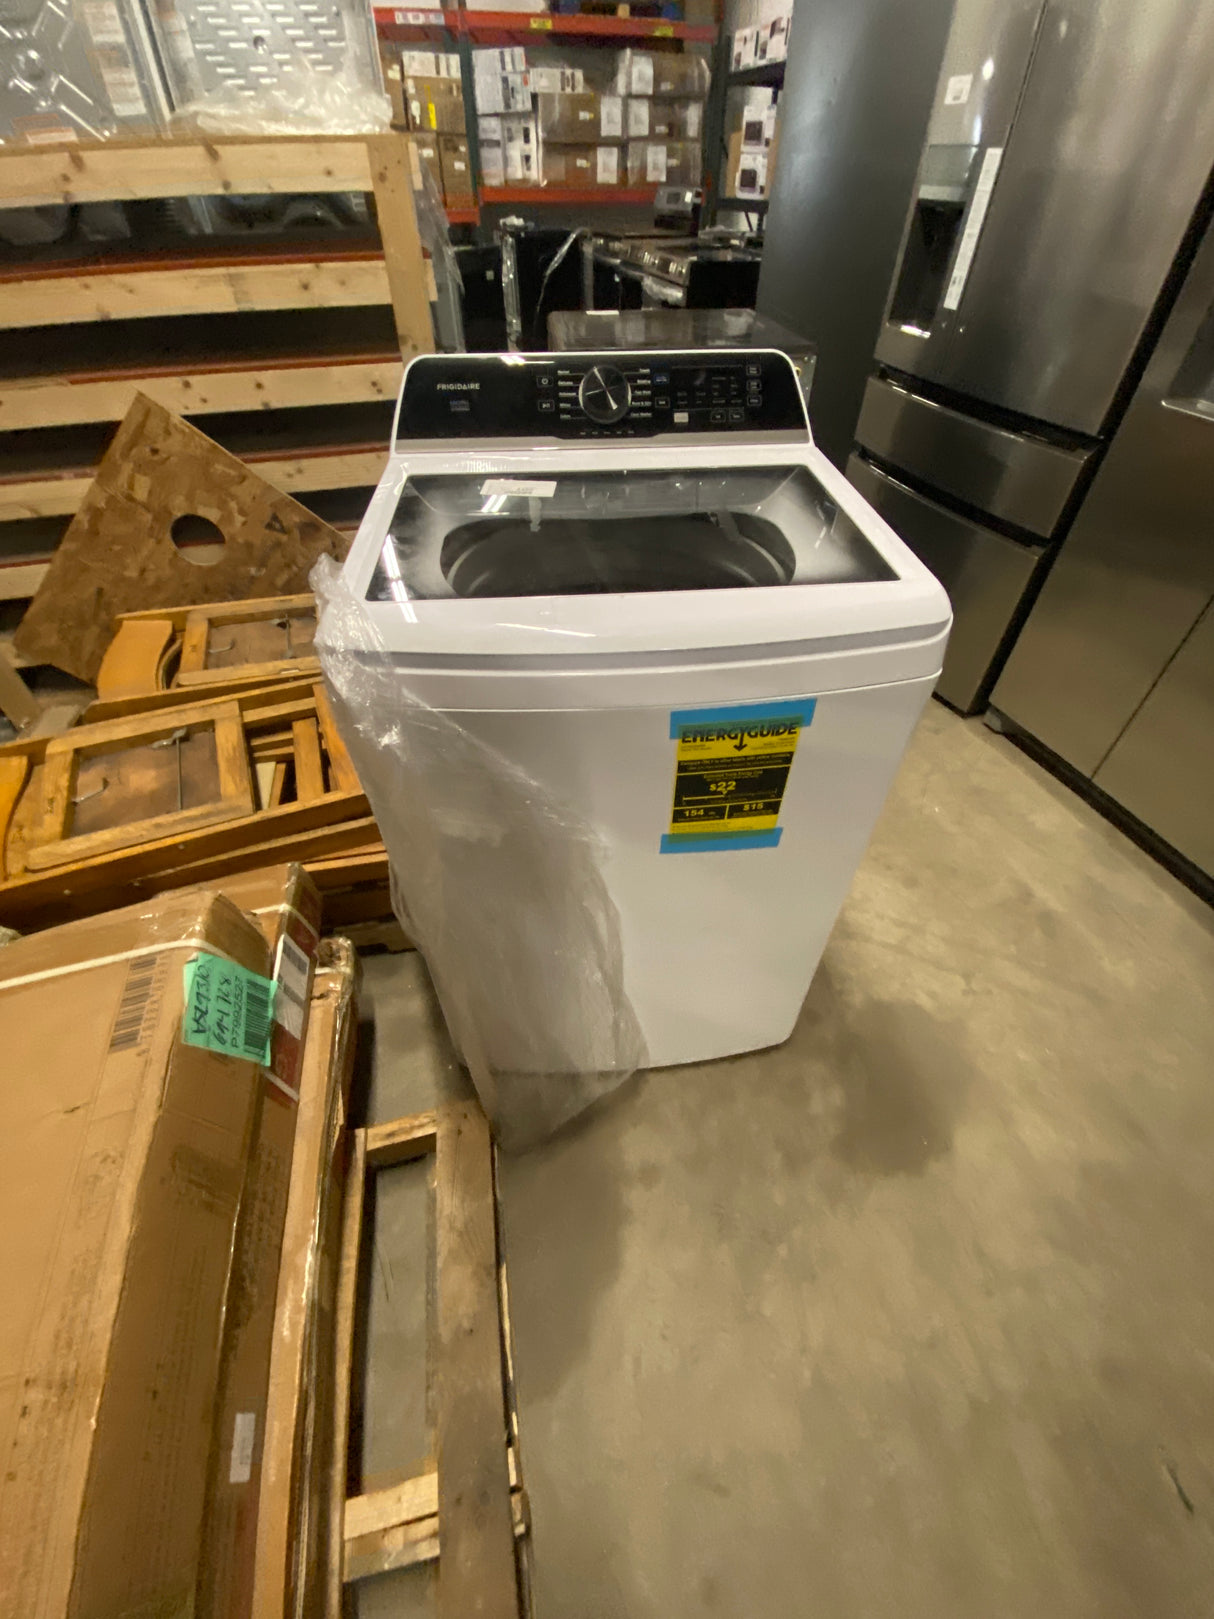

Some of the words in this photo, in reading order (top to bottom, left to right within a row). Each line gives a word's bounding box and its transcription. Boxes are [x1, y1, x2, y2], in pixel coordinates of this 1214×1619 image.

[436, 382, 481, 391] FRIGIDAIRE
[709, 781, 736, 791] $22
[684, 809, 704, 817] 154
